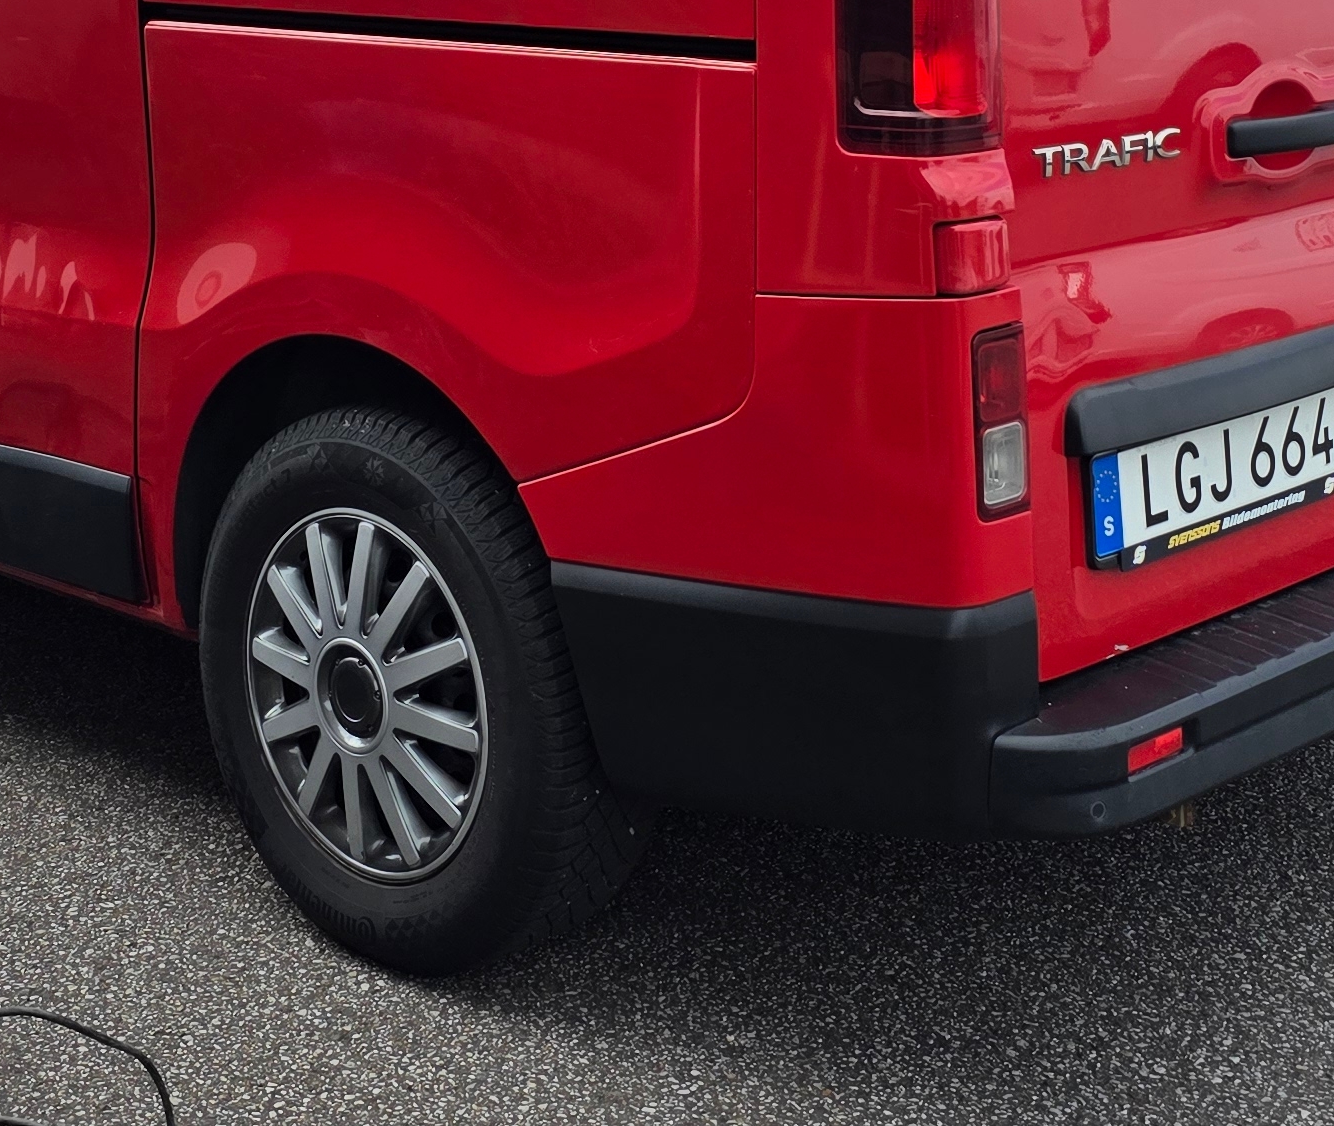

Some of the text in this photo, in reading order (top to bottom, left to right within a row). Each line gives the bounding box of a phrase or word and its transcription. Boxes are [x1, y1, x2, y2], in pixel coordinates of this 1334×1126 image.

[1031, 127, 1181, 178] TRAFIC
[1140, 397, 1334, 529] LGJ 664
[1104, 516, 1115, 536] S
[1222, 490, 1306, 530] Bildemontering
